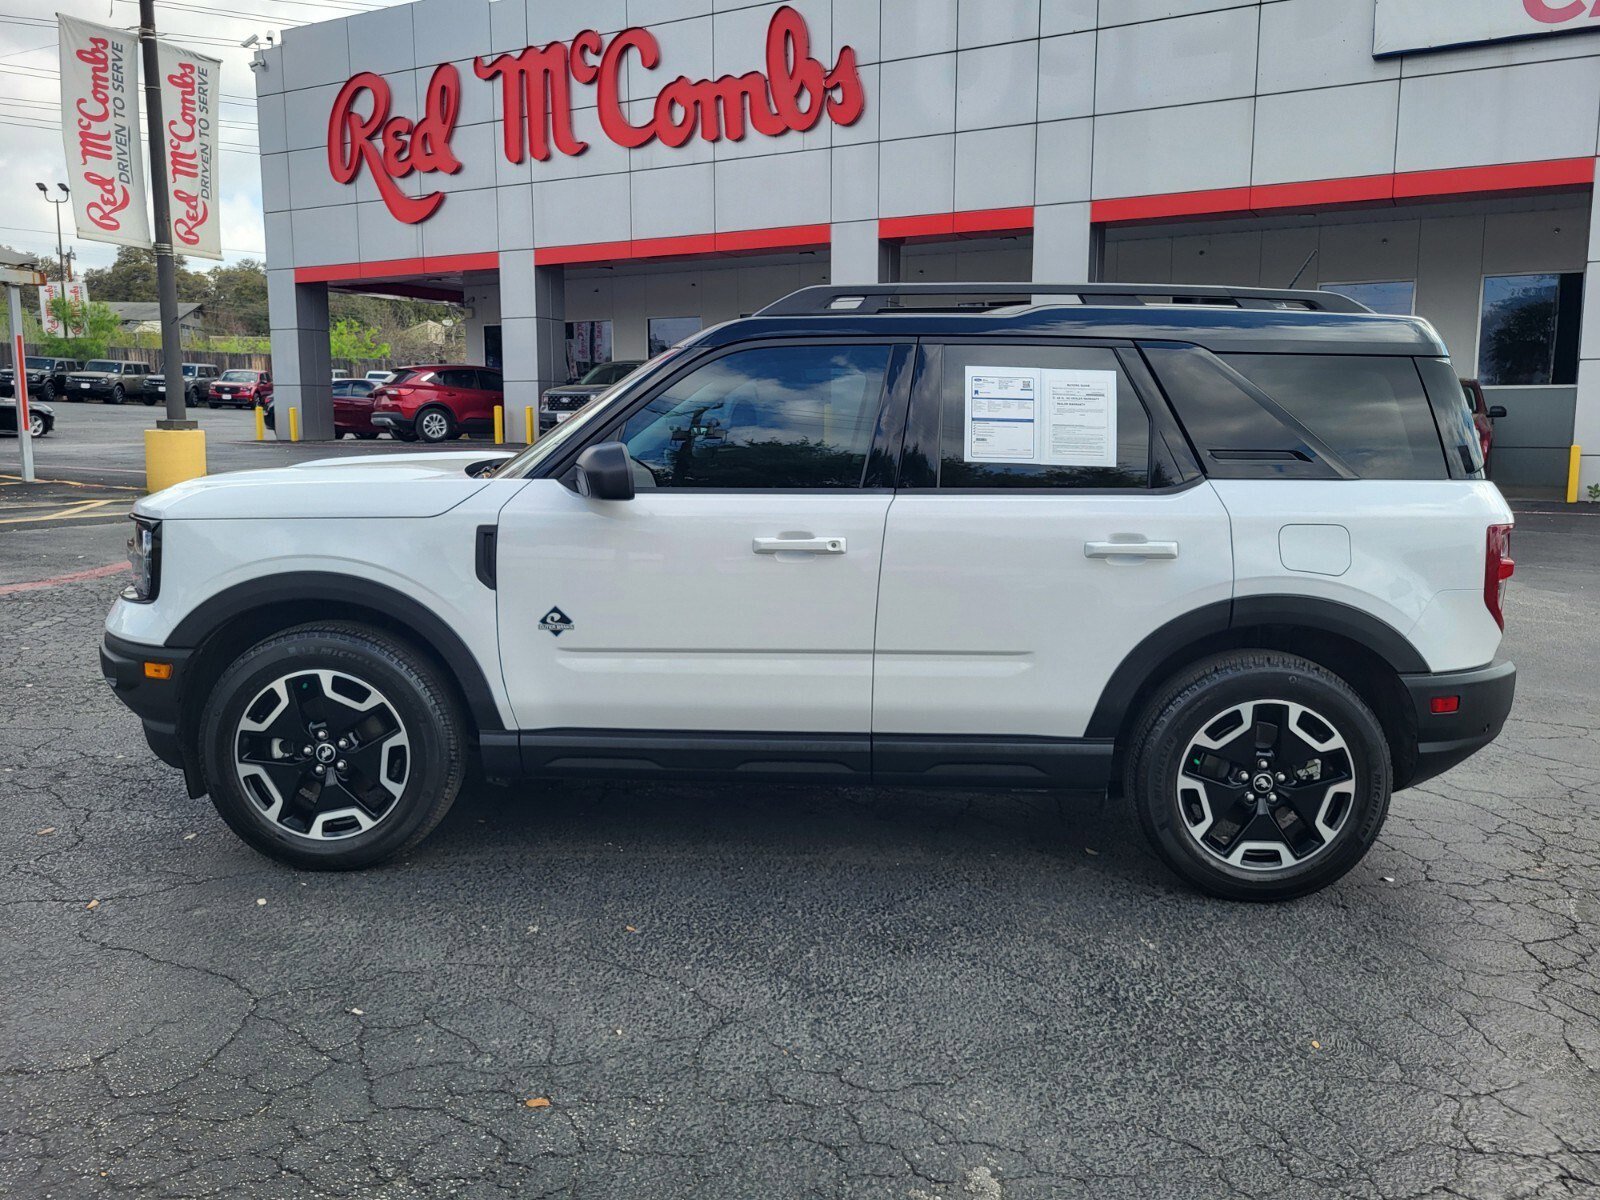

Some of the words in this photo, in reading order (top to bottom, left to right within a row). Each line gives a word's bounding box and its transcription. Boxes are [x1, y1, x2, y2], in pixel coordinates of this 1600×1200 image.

[111, 41, 125, 93] SERVE
[198, 66, 209, 115] SERVE
[75, 36, 113, 166] McCombs
[112, 98, 125, 118] TO
[167, 62, 199, 184] McCombs
[198, 119, 210, 139] TO
[328, 63, 465, 225] Red
[474, 5, 864, 164] McCombs
[115, 127, 129, 185] DRIVEN
[200, 144, 210, 200] DRIVEN
[84, 171, 130, 232] Red
[173, 189, 208, 246] Red
